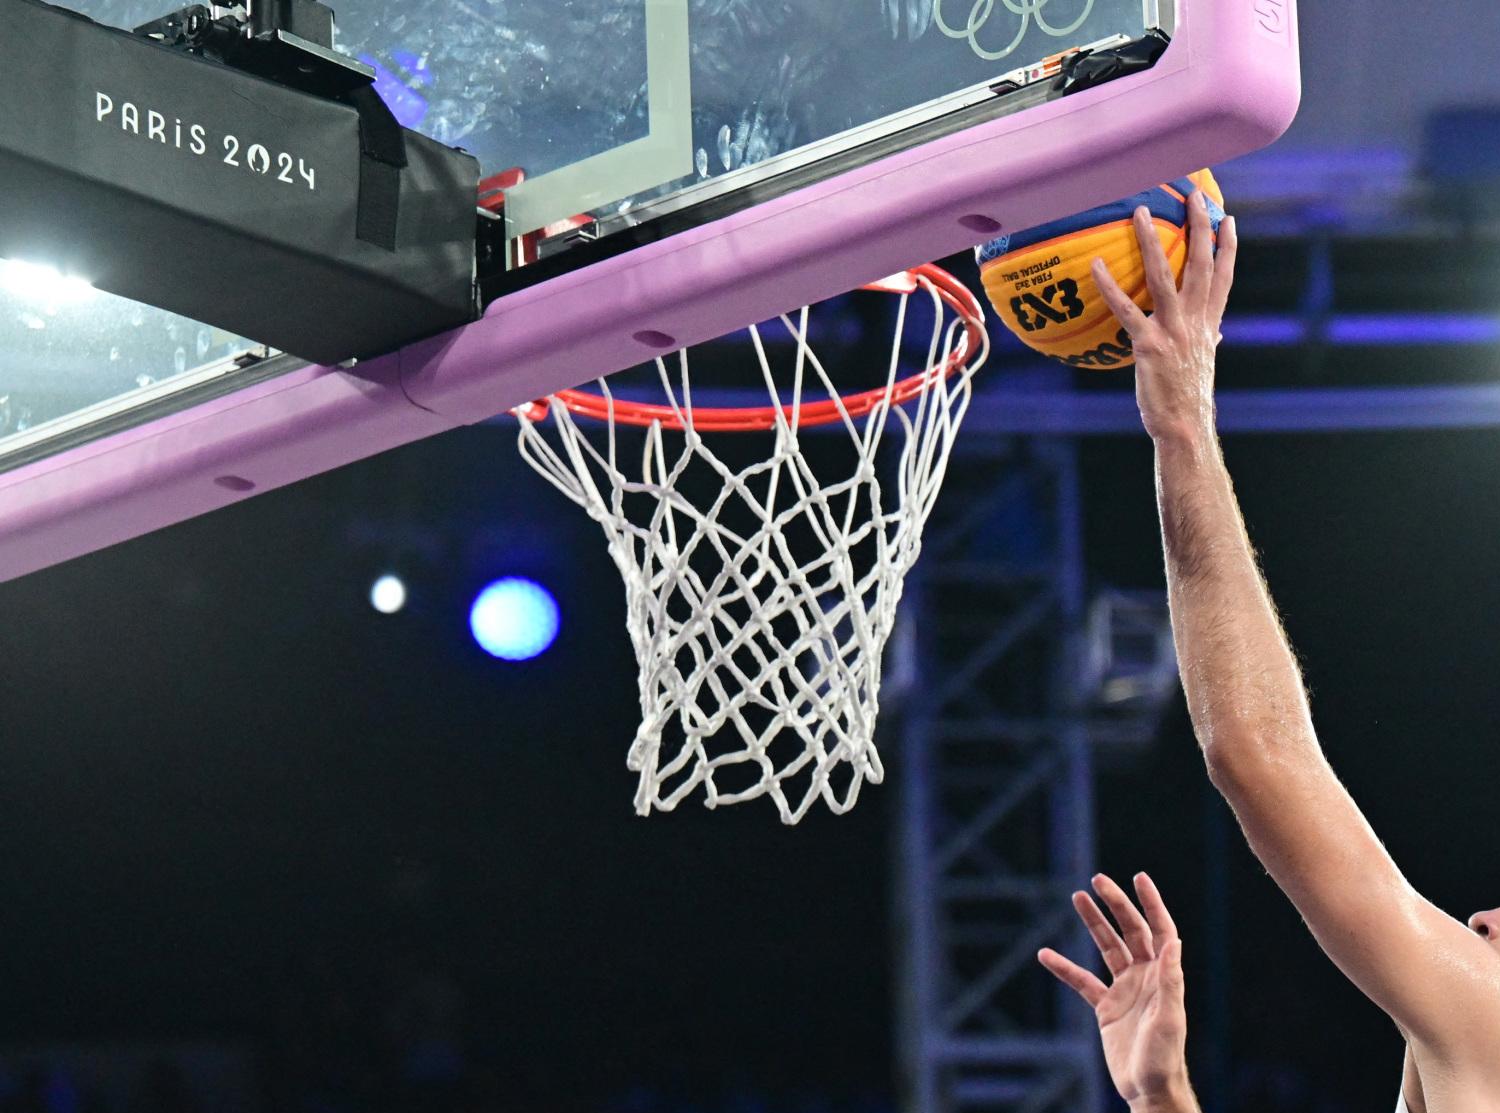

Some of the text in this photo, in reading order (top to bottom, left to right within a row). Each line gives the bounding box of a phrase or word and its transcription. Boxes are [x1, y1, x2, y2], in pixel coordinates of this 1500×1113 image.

[223, 134, 315, 190] 2024
[1020, 255, 1061, 277] OFFICIAL
[1031, 270, 1053, 286] FIBA
